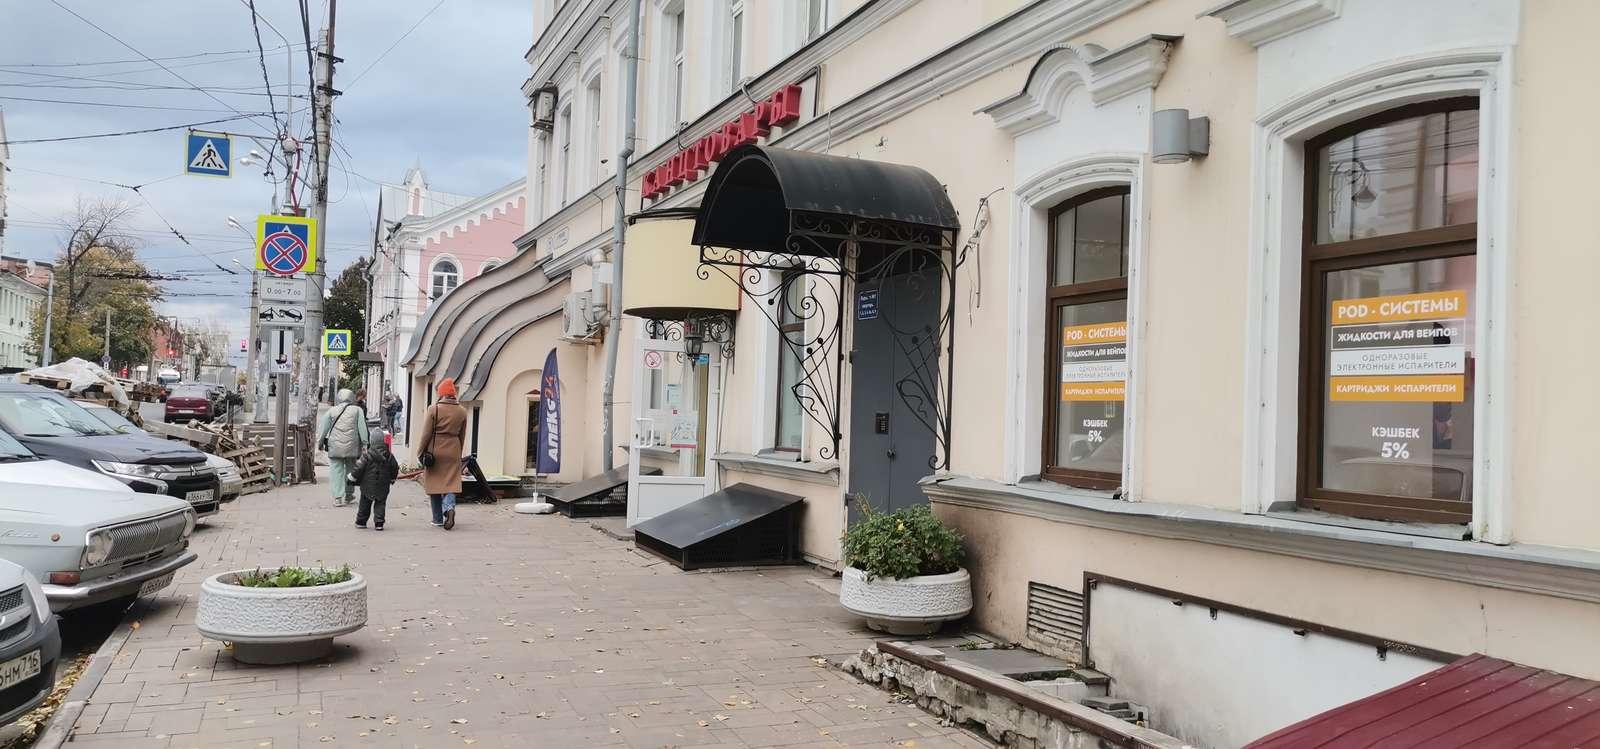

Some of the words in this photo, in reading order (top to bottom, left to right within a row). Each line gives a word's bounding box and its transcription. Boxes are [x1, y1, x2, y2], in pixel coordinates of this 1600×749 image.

[641, 84, 802, 199] КАНЦТОВАРЫ
[1338, 304, 1369, 319] POD
[1380, 297, 1459, 316] СИСТЕМЫ
[1066, 330, 1083, 340] POD
[1337, 330, 1391, 342] ЖИДКОСТИ
[1393, 329, 1414, 341] ДЛЯ
[1095, 348, 1106, 357] ДЛЯ
[1361, 353, 1428, 362] ОДНОРАЗОВЫЕ
[1337, 363, 1395, 371] ЭЛЕКТРОННЫЕ
[1398, 361, 1457, 370] ИСПАРИТЕЛИ
[1336, 384, 1390, 393] КАРТРИДЖИ
[1394, 384, 1457, 393] ИСПАРИТЕЛИ
[1083, 419, 1108, 428] КЭШБЕК
[1088, 430, 1103, 442] 5%
[1372, 426, 1420, 439] КЭШБЕК
[1381, 441, 1410, 459] 5%
